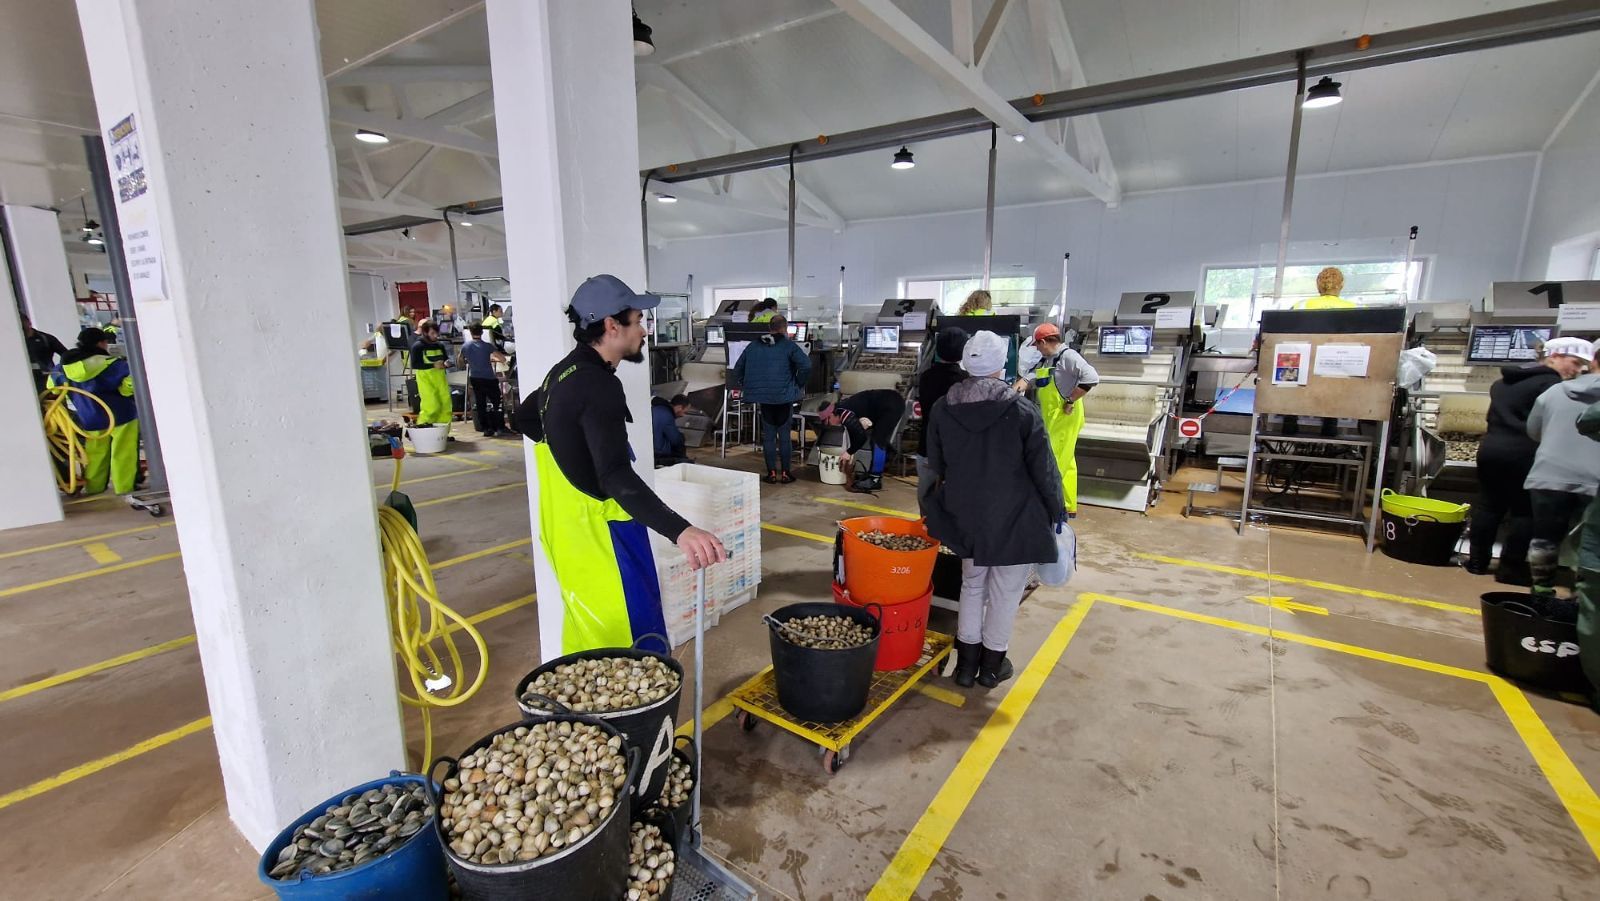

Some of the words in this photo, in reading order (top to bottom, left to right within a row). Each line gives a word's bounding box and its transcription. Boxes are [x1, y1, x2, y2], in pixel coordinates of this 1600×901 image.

[1141, 293, 1171, 314] 2
[1528, 283, 1565, 309] 1
[724, 300, 741, 315] 4
[894, 300, 916, 317] 3
[890, 566, 912, 575] 3206
[638, 714, 674, 797] A
